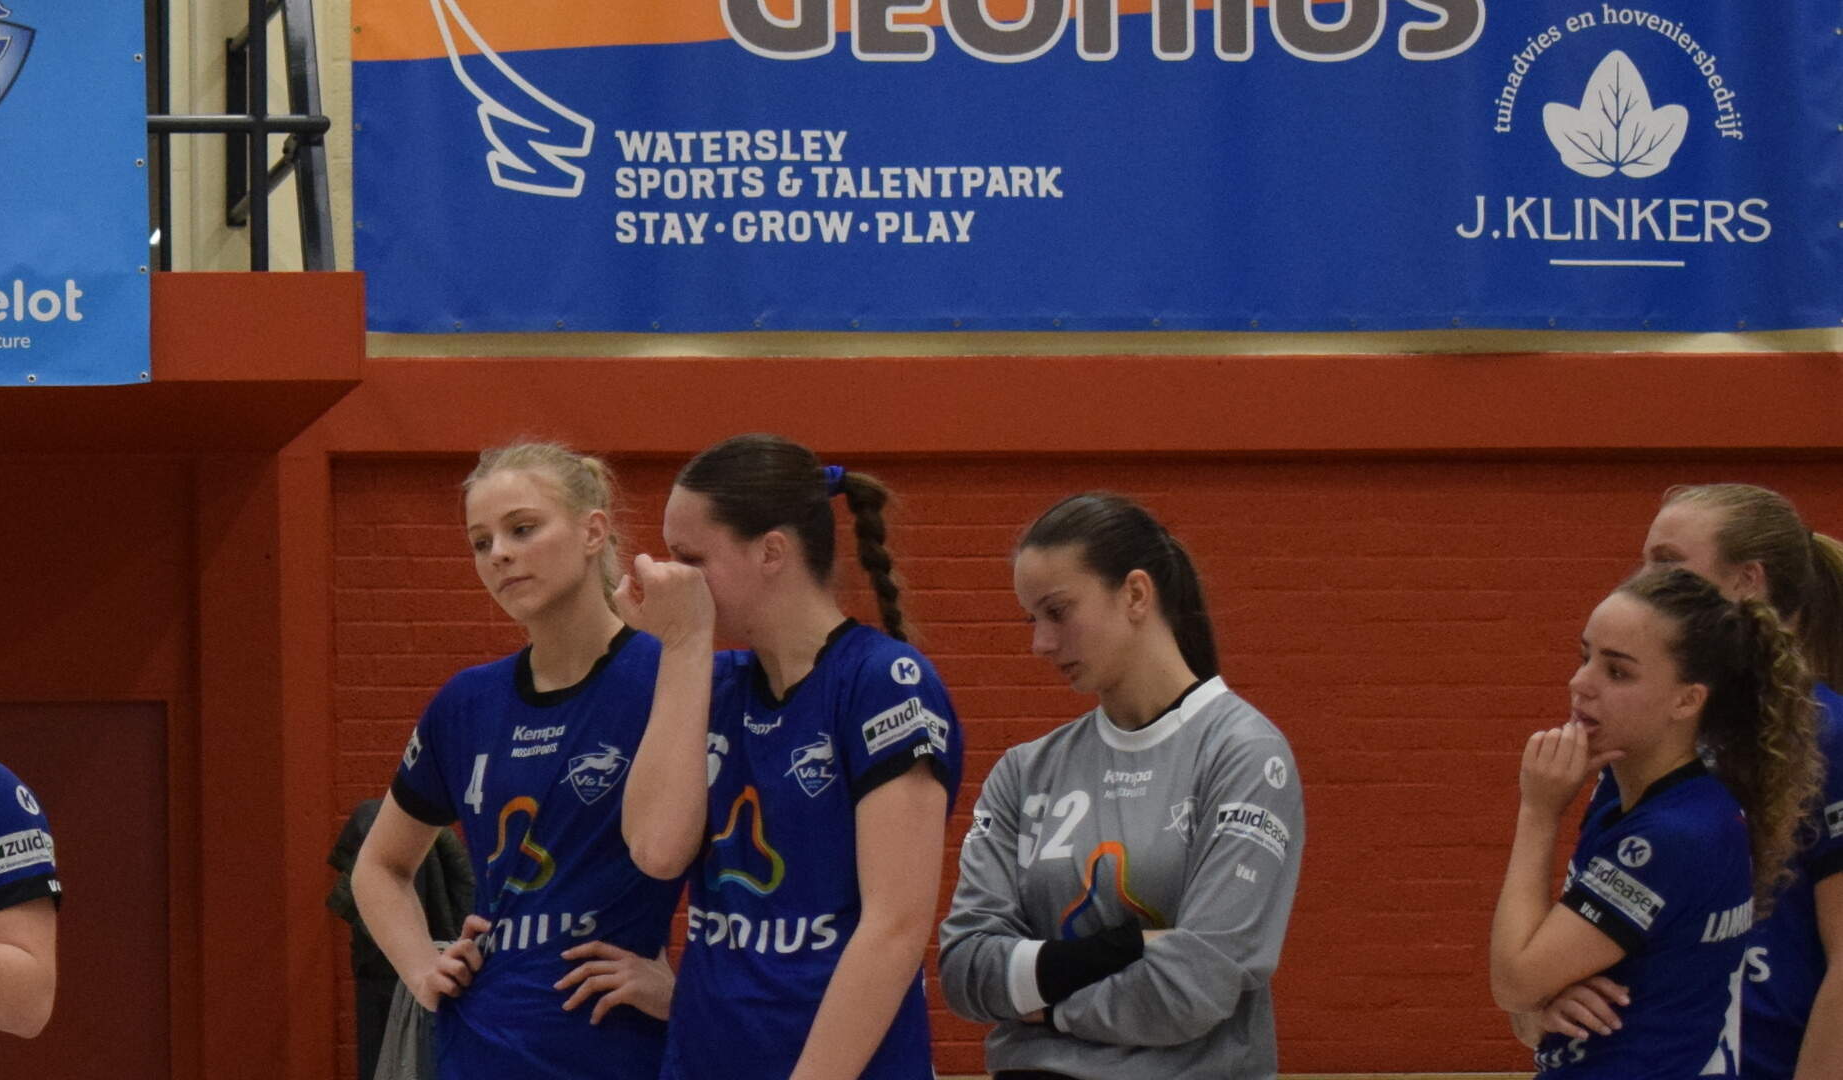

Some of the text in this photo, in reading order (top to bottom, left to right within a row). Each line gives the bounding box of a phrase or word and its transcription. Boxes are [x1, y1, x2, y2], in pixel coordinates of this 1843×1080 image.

[1494, 3, 1744, 140] tuinadvies en hoveniersbedrijf
[615, 130, 848, 163] WATERSLEY
[615, 166, 1063, 200] SPORTS & TALENTPARK
[513, 724, 565, 742] Kempa
[463, 754, 489, 814] 4
[574, 775, 611, 787] V&L
[687, 905, 838, 954] EONIUS
